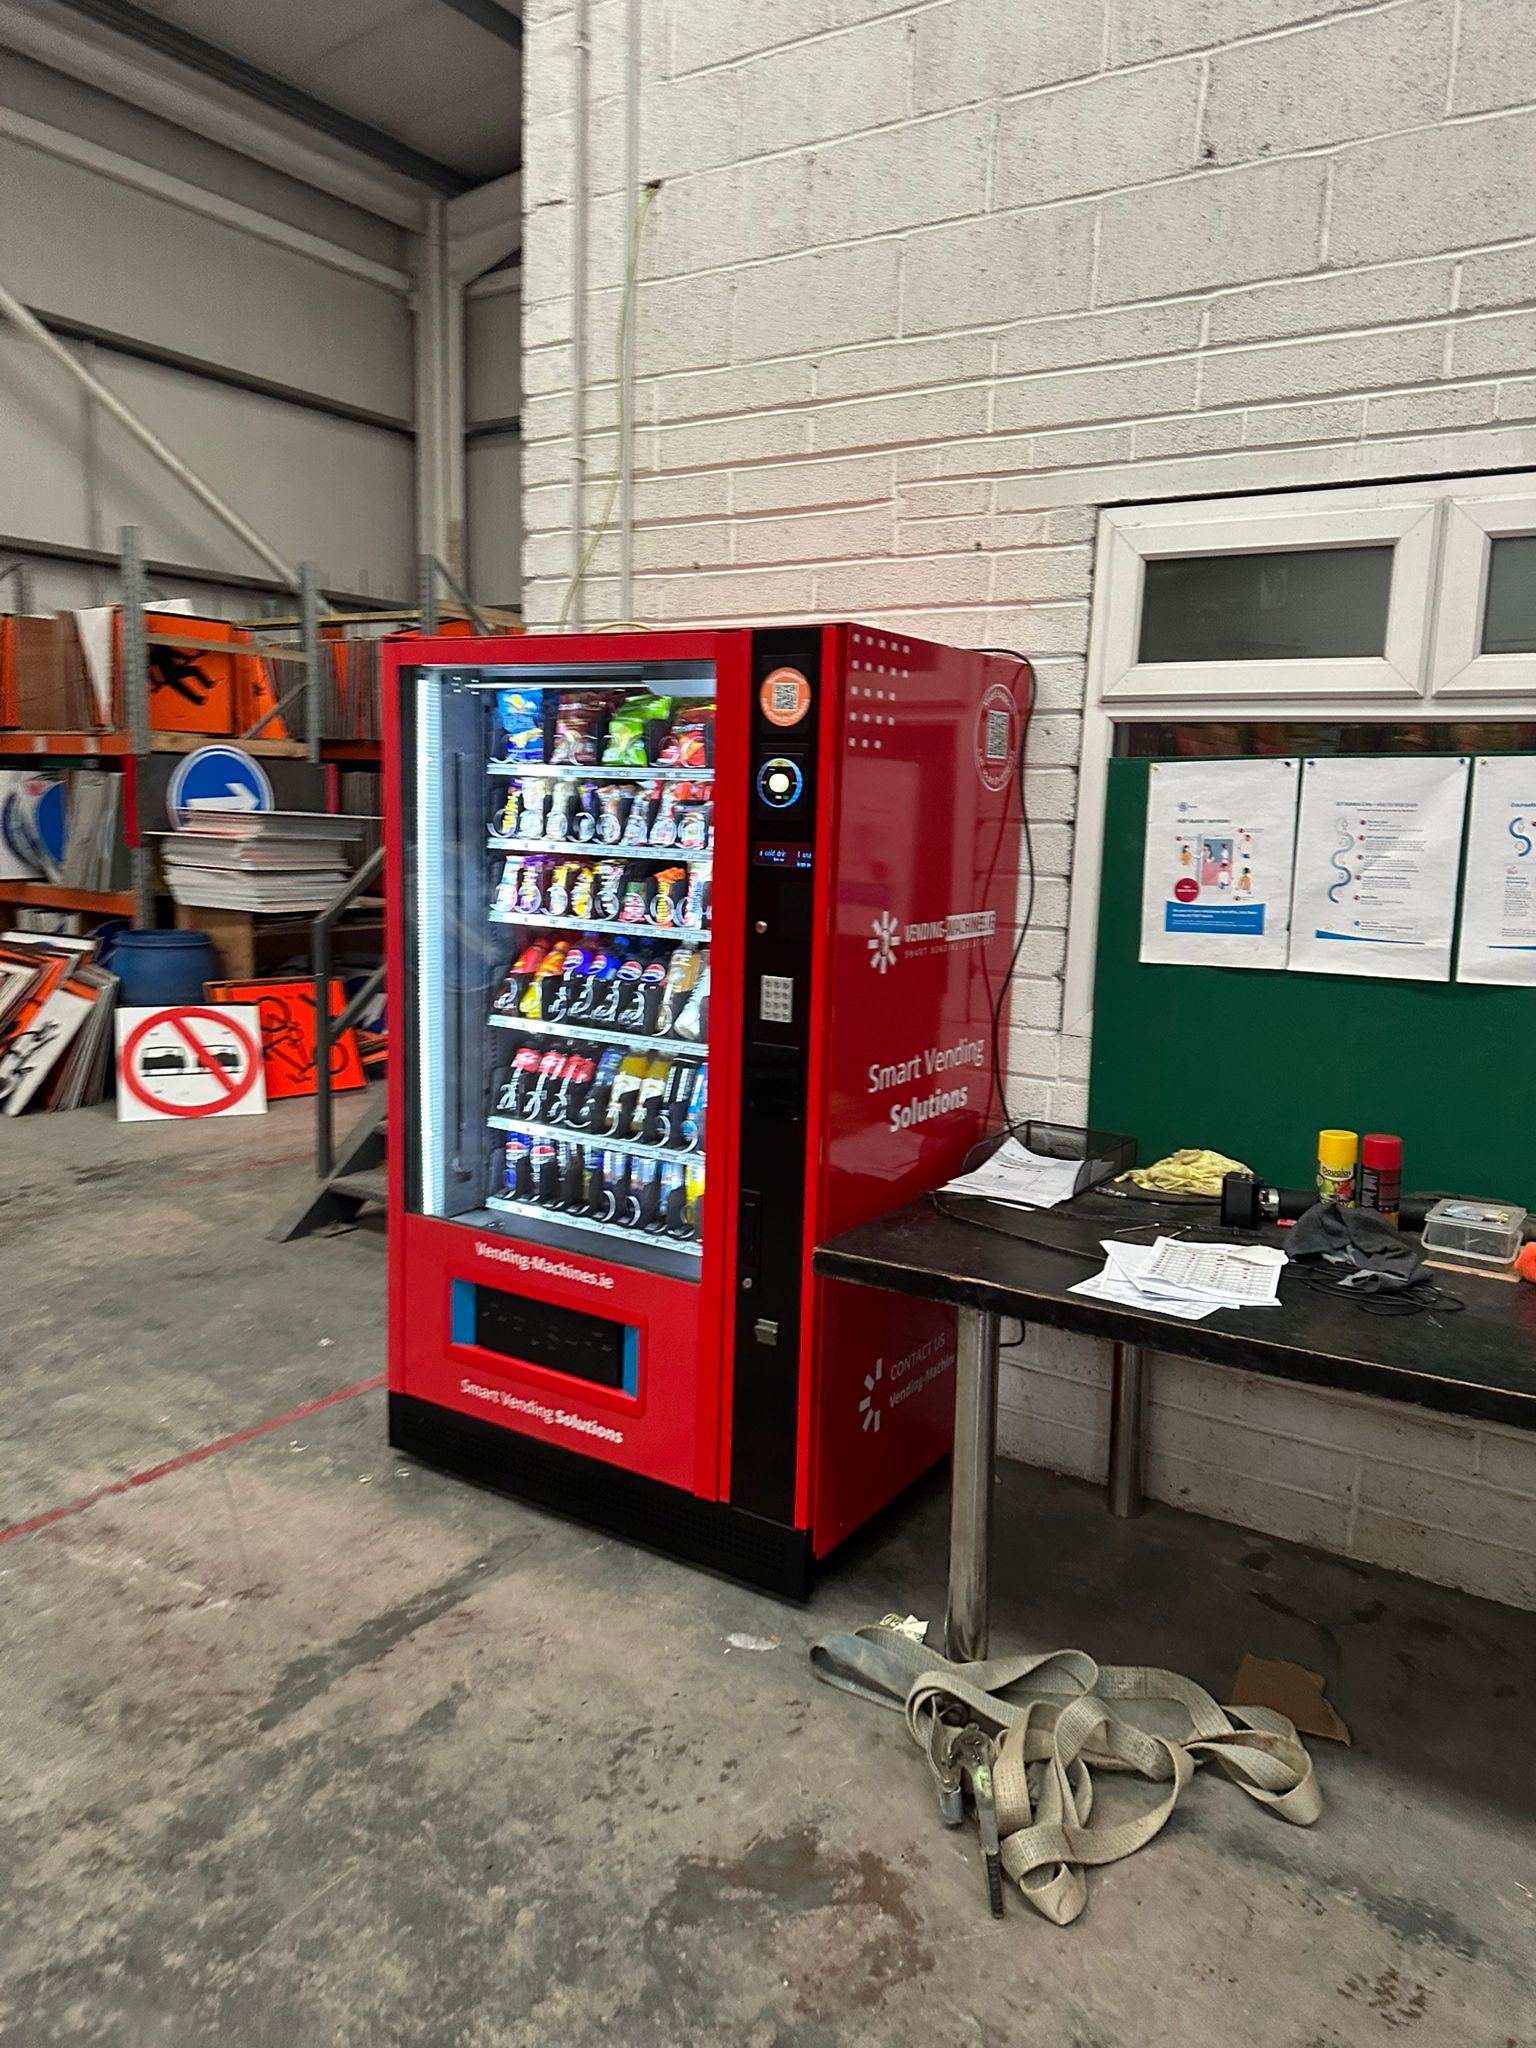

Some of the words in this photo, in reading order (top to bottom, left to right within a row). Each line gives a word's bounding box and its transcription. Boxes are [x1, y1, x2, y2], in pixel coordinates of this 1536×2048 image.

[868, 1055, 922, 1094] Smart
[923, 1038, 985, 1075] Vending
[890, 1086, 968, 1133] Solutions
[474, 1241, 615, 1289] Vending-Machines.ie
[890, 1341, 933, 1381] CONTACT
[934, 1332, 945, 1352] US
[460, 1378, 500, 1403] Smart
[501, 1391, 554, 1424] Vending
[555, 1409, 625, 1444] Solutions
